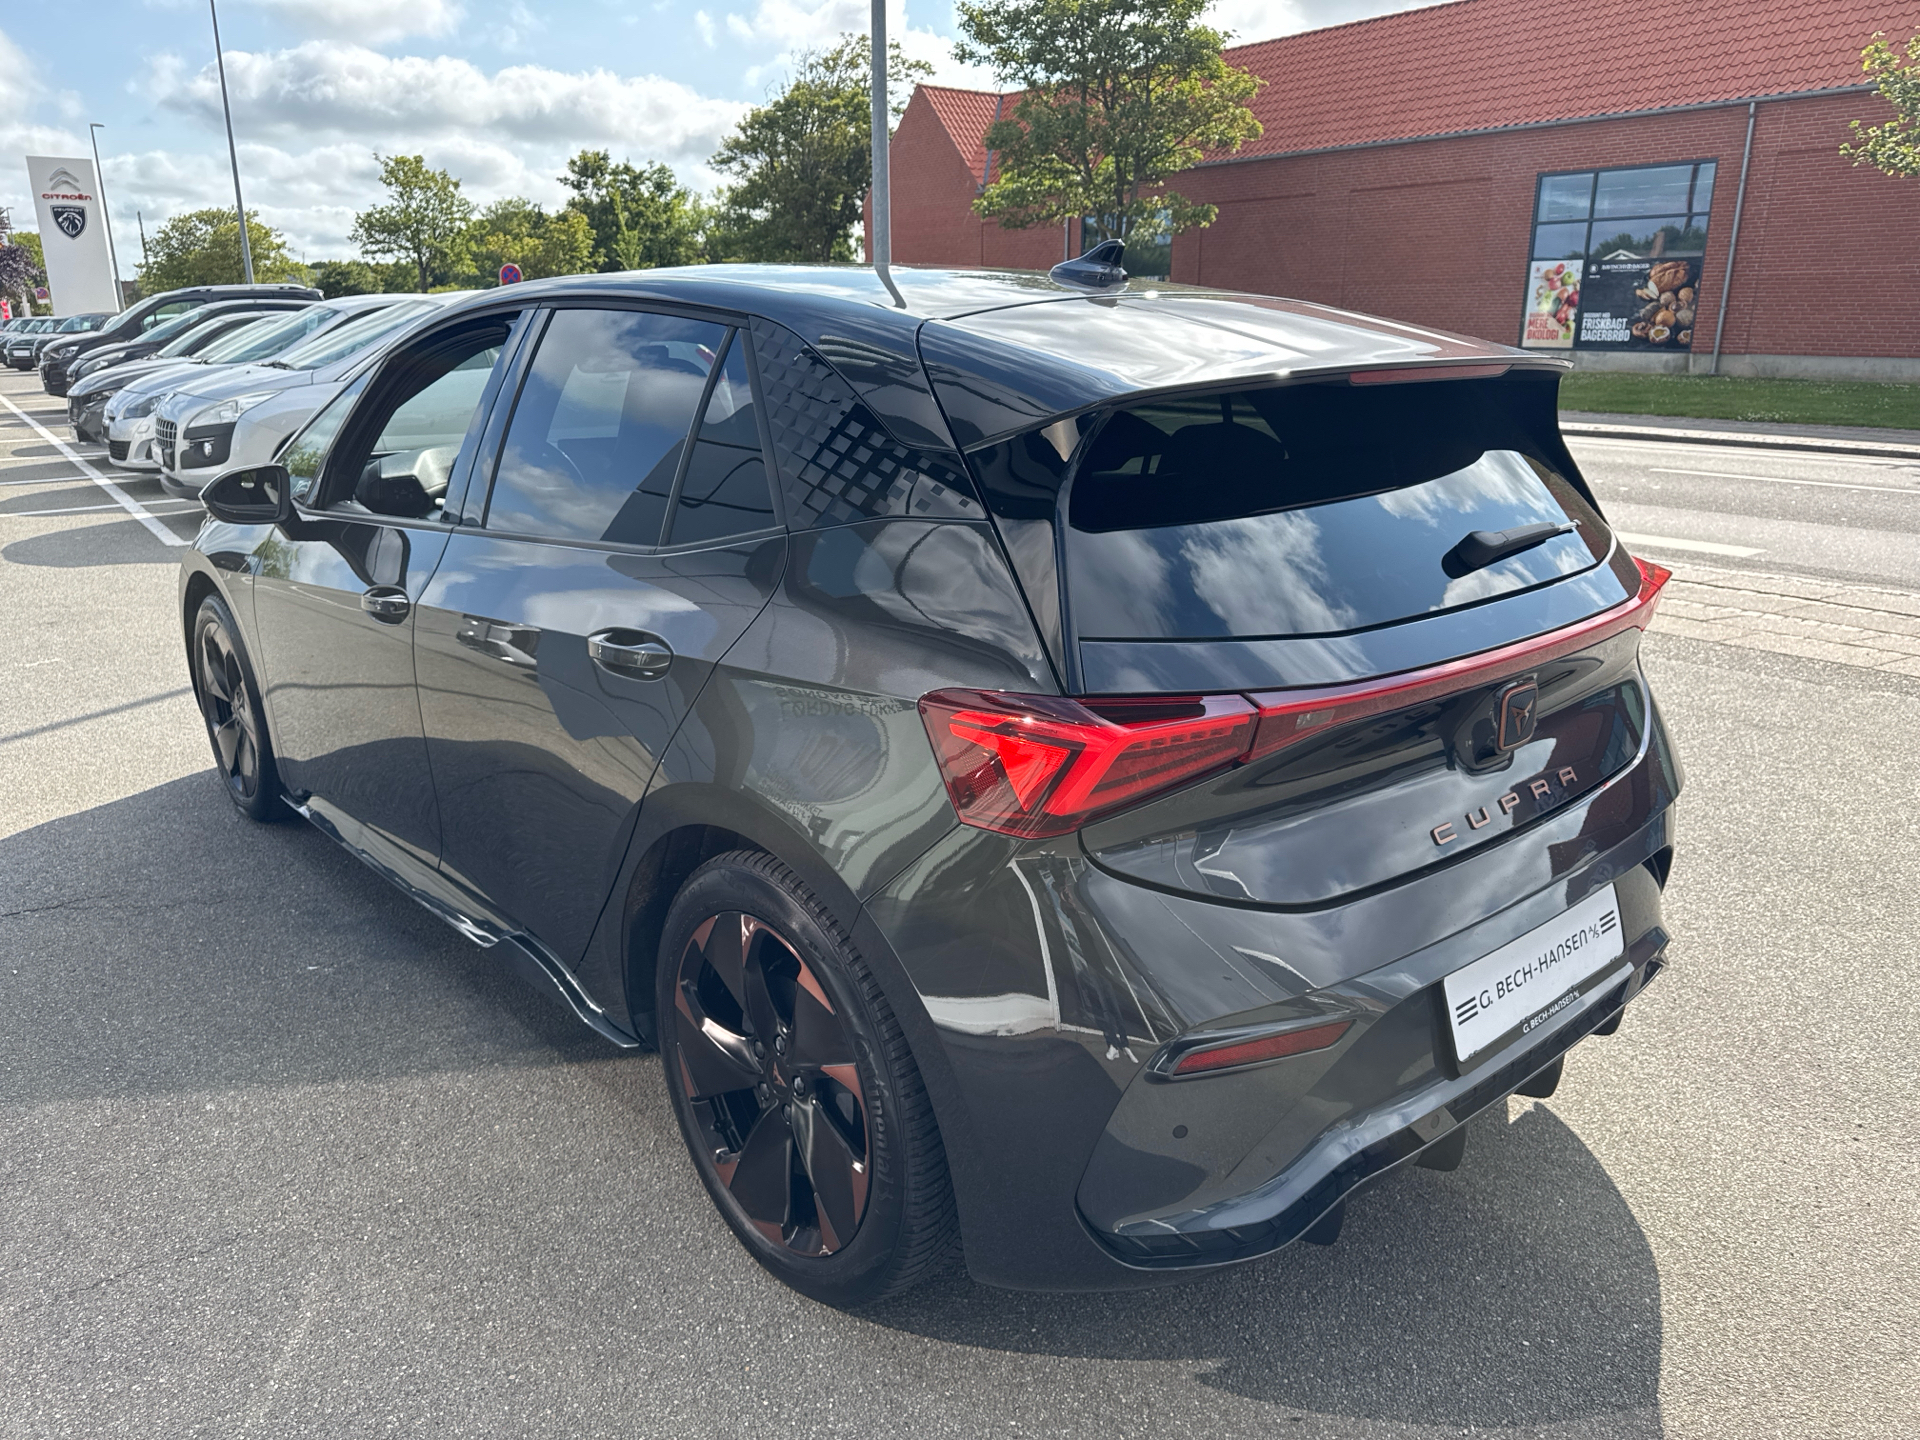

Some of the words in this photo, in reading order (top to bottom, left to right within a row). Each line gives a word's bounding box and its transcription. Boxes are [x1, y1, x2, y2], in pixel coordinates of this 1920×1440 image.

[1528, 318, 1549, 329] MERE
[1582, 318, 1628, 330] FRISKBAGT
[1526, 329, 1559, 340] ØKOLOGI
[1580, 329, 1630, 342] BAGERBRØD
[1430, 766, 1578, 846] CUPRA
[1479, 989, 1494, 1009] G.
[1496, 929, 1588, 1000] BECH-HANSEN
[1588, 924, 1600, 939] A/S
[1530, 993, 1574, 1029] BECH-HANSEN
